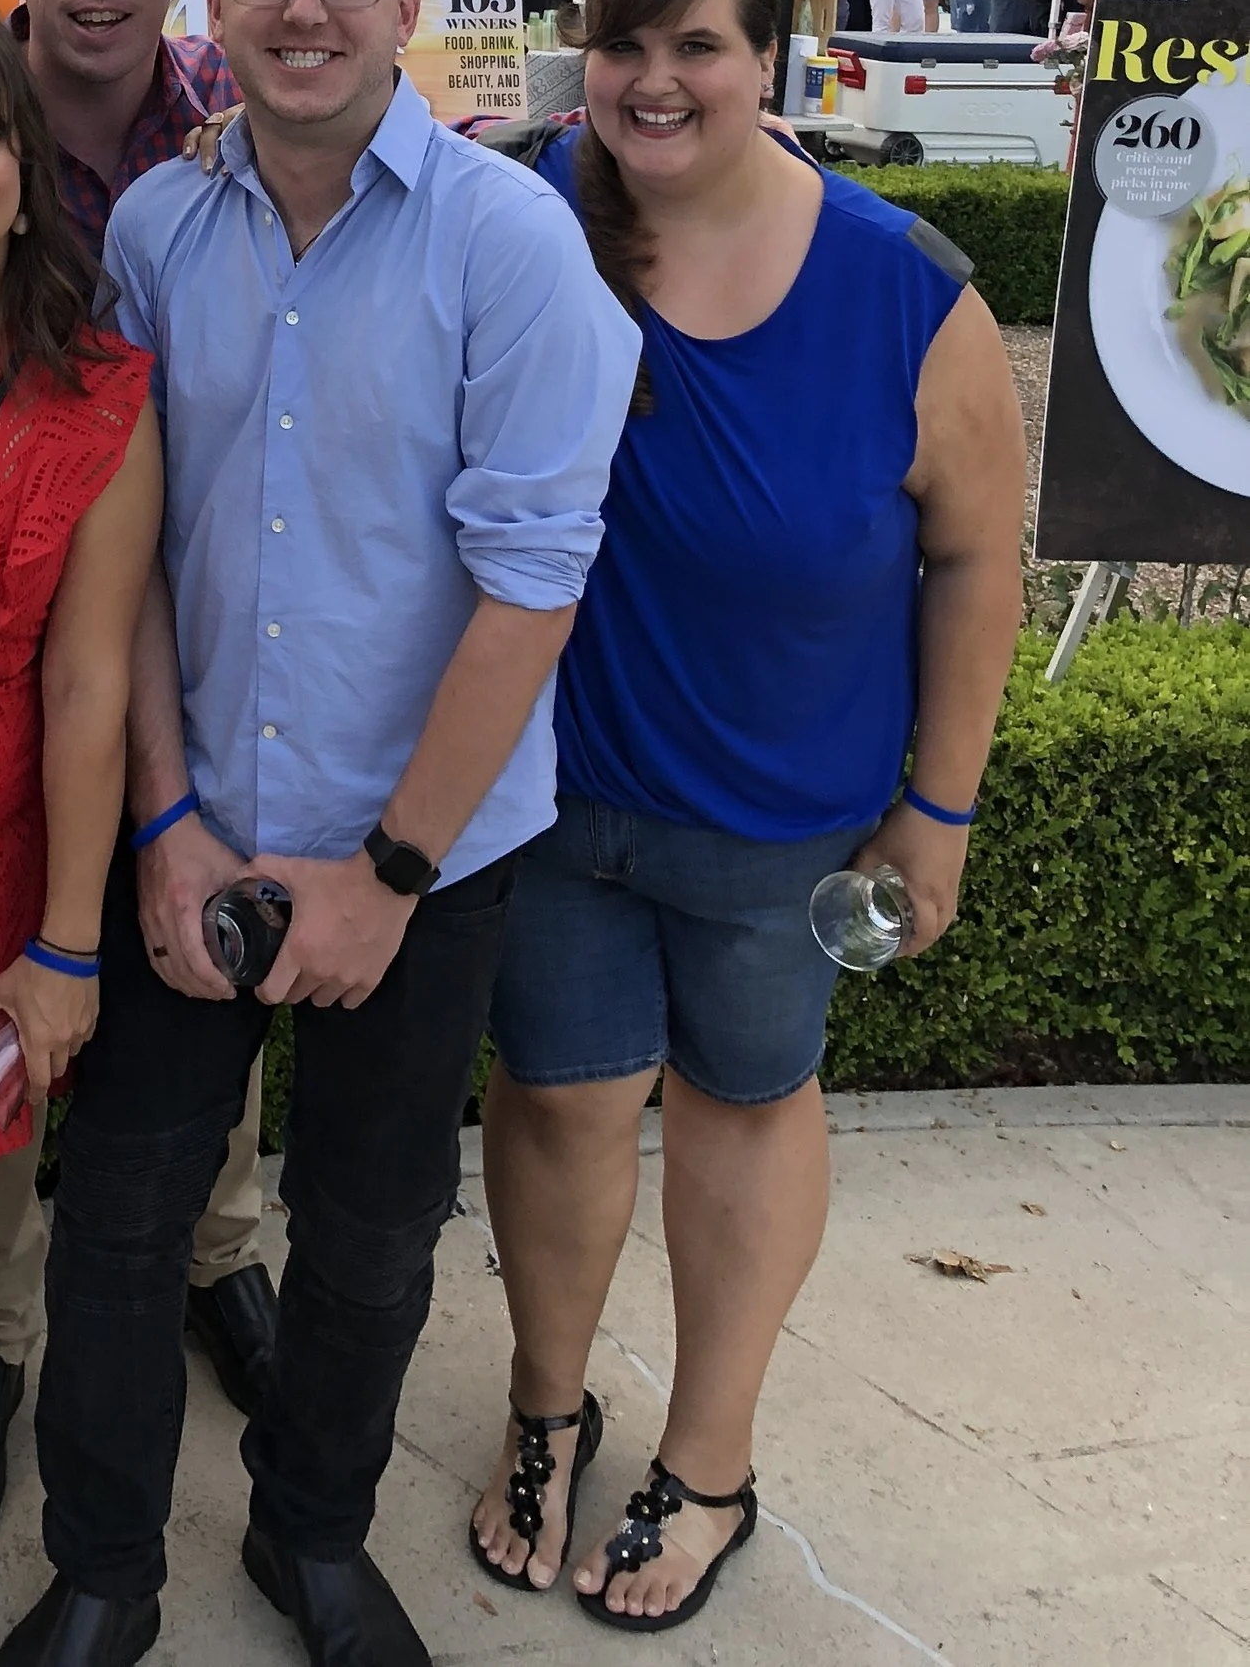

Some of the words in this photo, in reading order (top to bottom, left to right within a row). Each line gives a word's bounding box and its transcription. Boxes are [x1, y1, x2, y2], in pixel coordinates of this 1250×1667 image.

[445, 18, 517, 30] WINNERS
[444, 36, 477, 51] FOOD,
[481, 35, 519, 51] DRINK,
[459, 55, 520, 70] SHOPPING,
[448, 74, 494, 90] BEAUTY,
[497, 74, 520, 89] AND
[476, 93, 522, 108] FITNESS
[1112, 109, 1201, 150] 260
[1165, 153, 1192, 166] and
[1110, 177, 1147, 190] picks
[1165, 181, 1191, 192] one
[1126, 190, 1148, 202] hot
[1151, 190, 1173, 203] list
